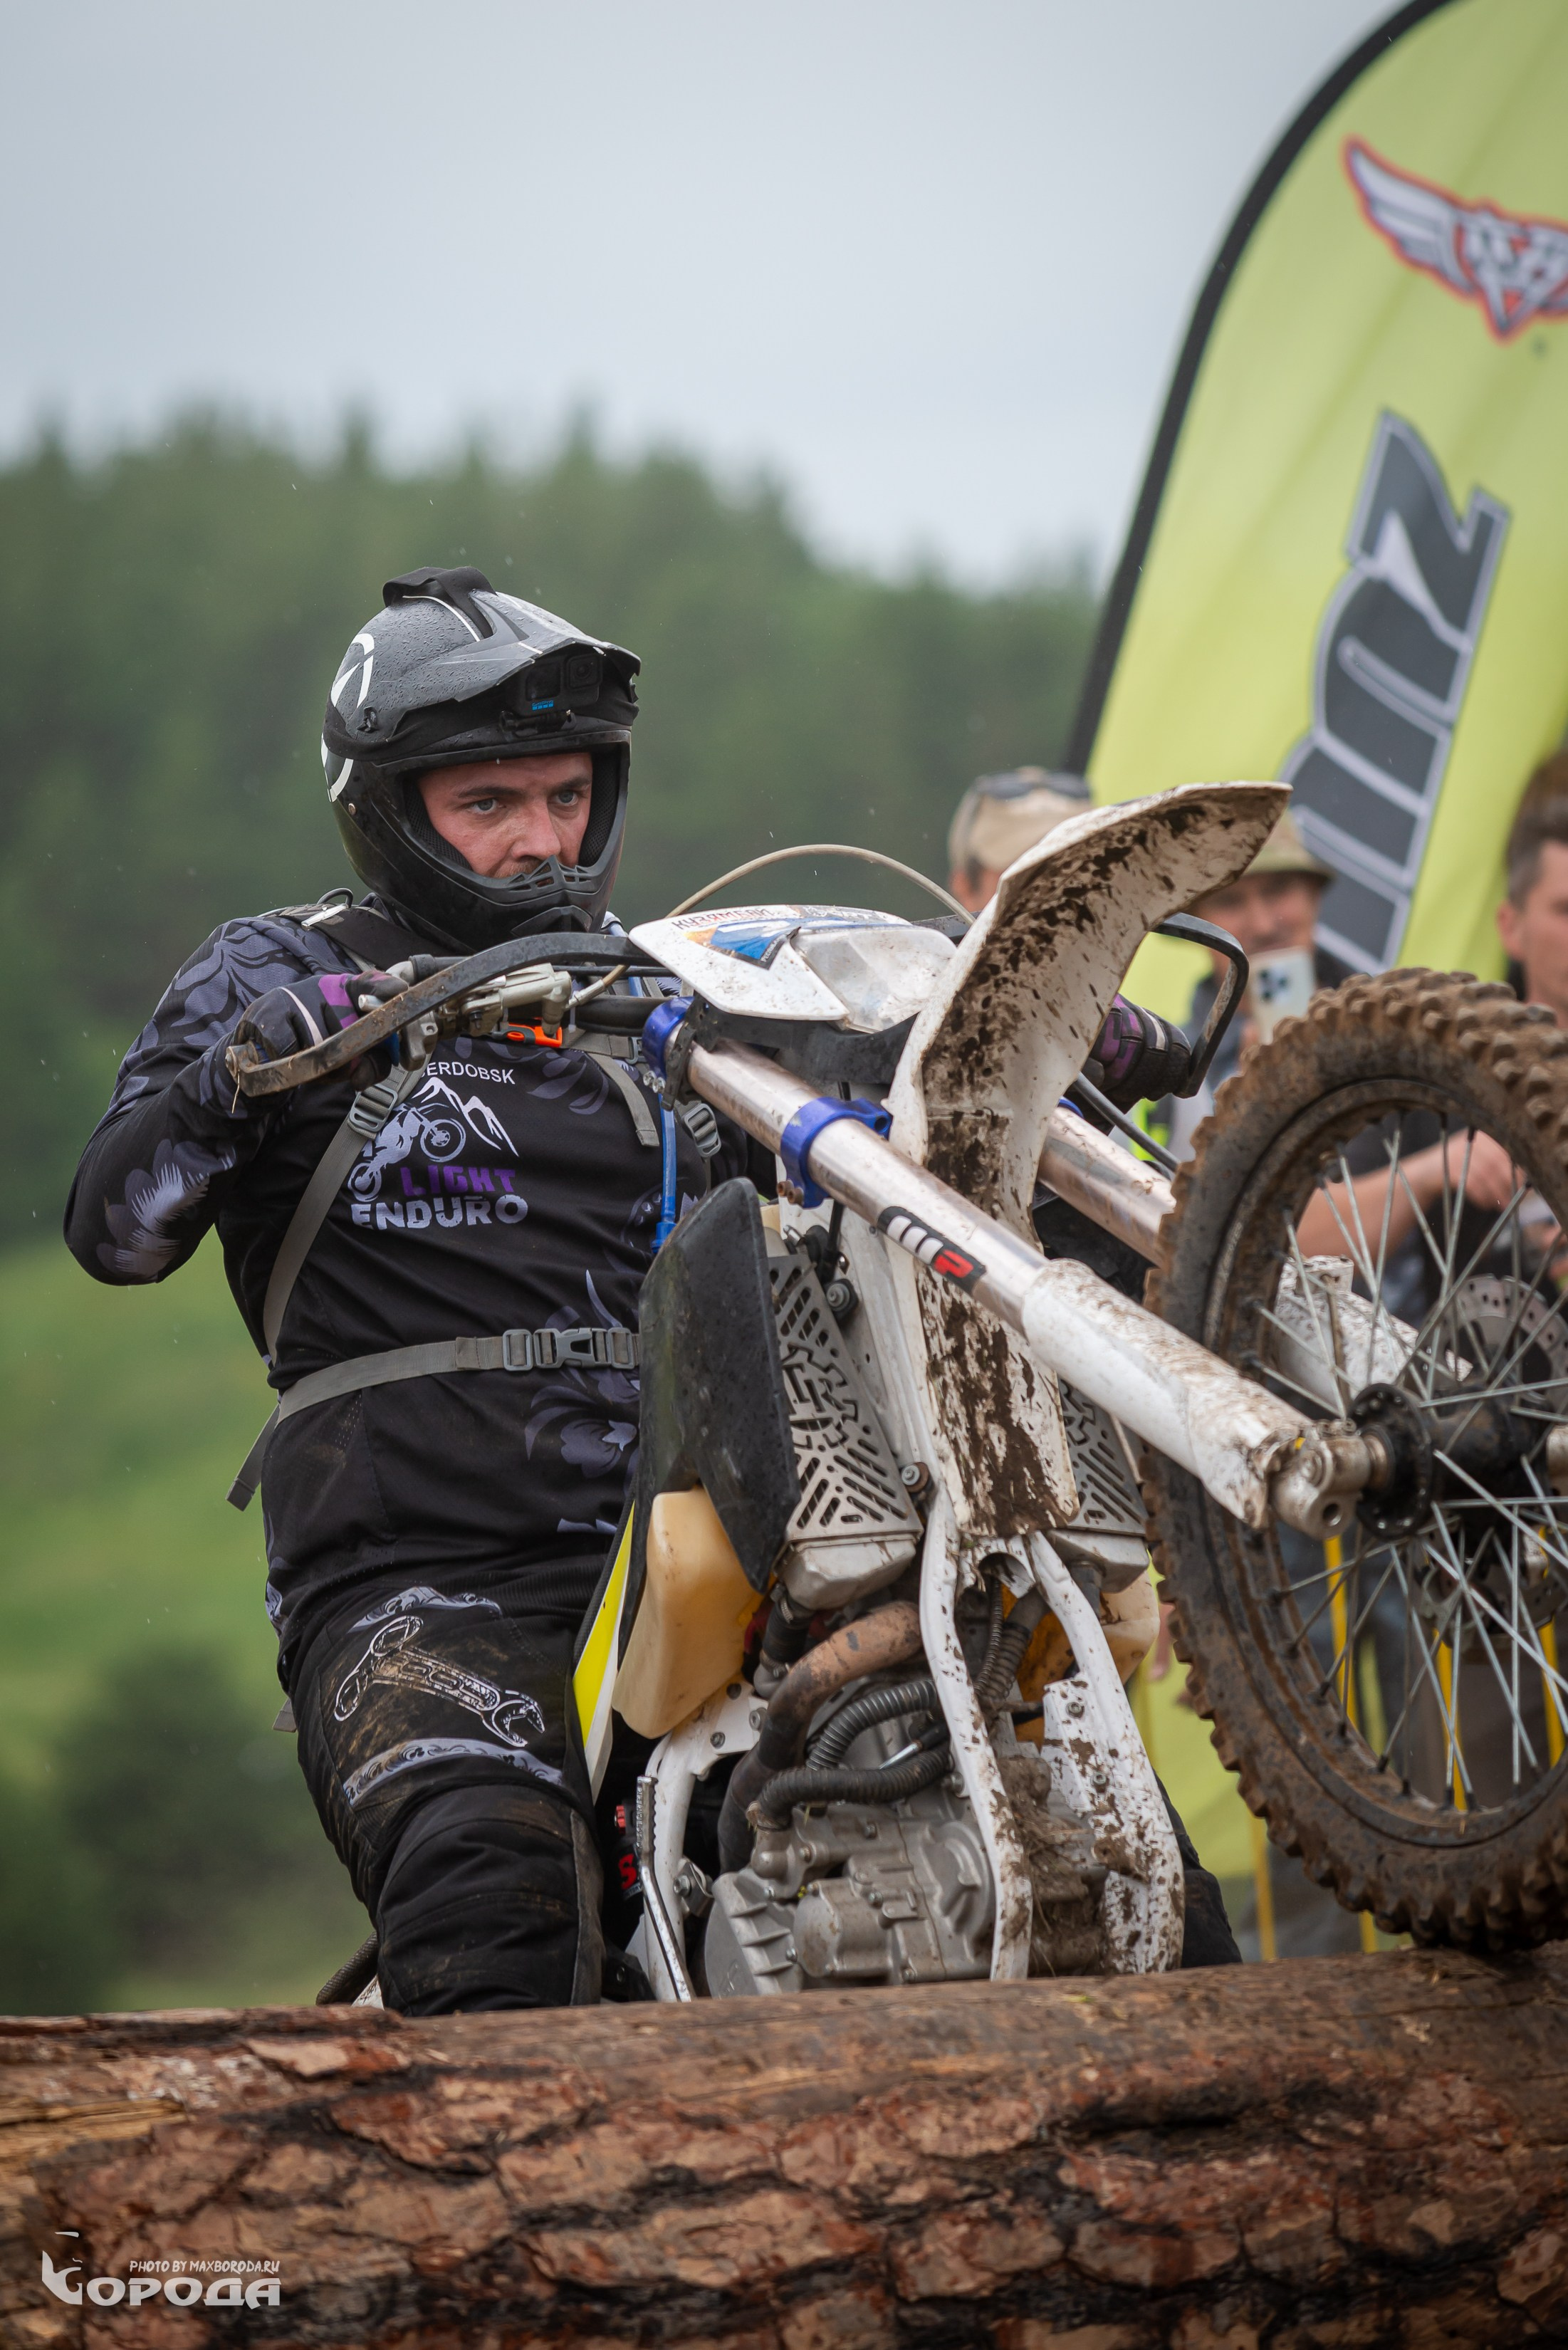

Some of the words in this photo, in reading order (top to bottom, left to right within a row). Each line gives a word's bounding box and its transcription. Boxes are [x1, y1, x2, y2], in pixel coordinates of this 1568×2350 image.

[421, 1061, 516, 1085] ERDOBSK
[400, 1165, 516, 1196] LIGHT
[350, 1194, 528, 1231] ENDURO
